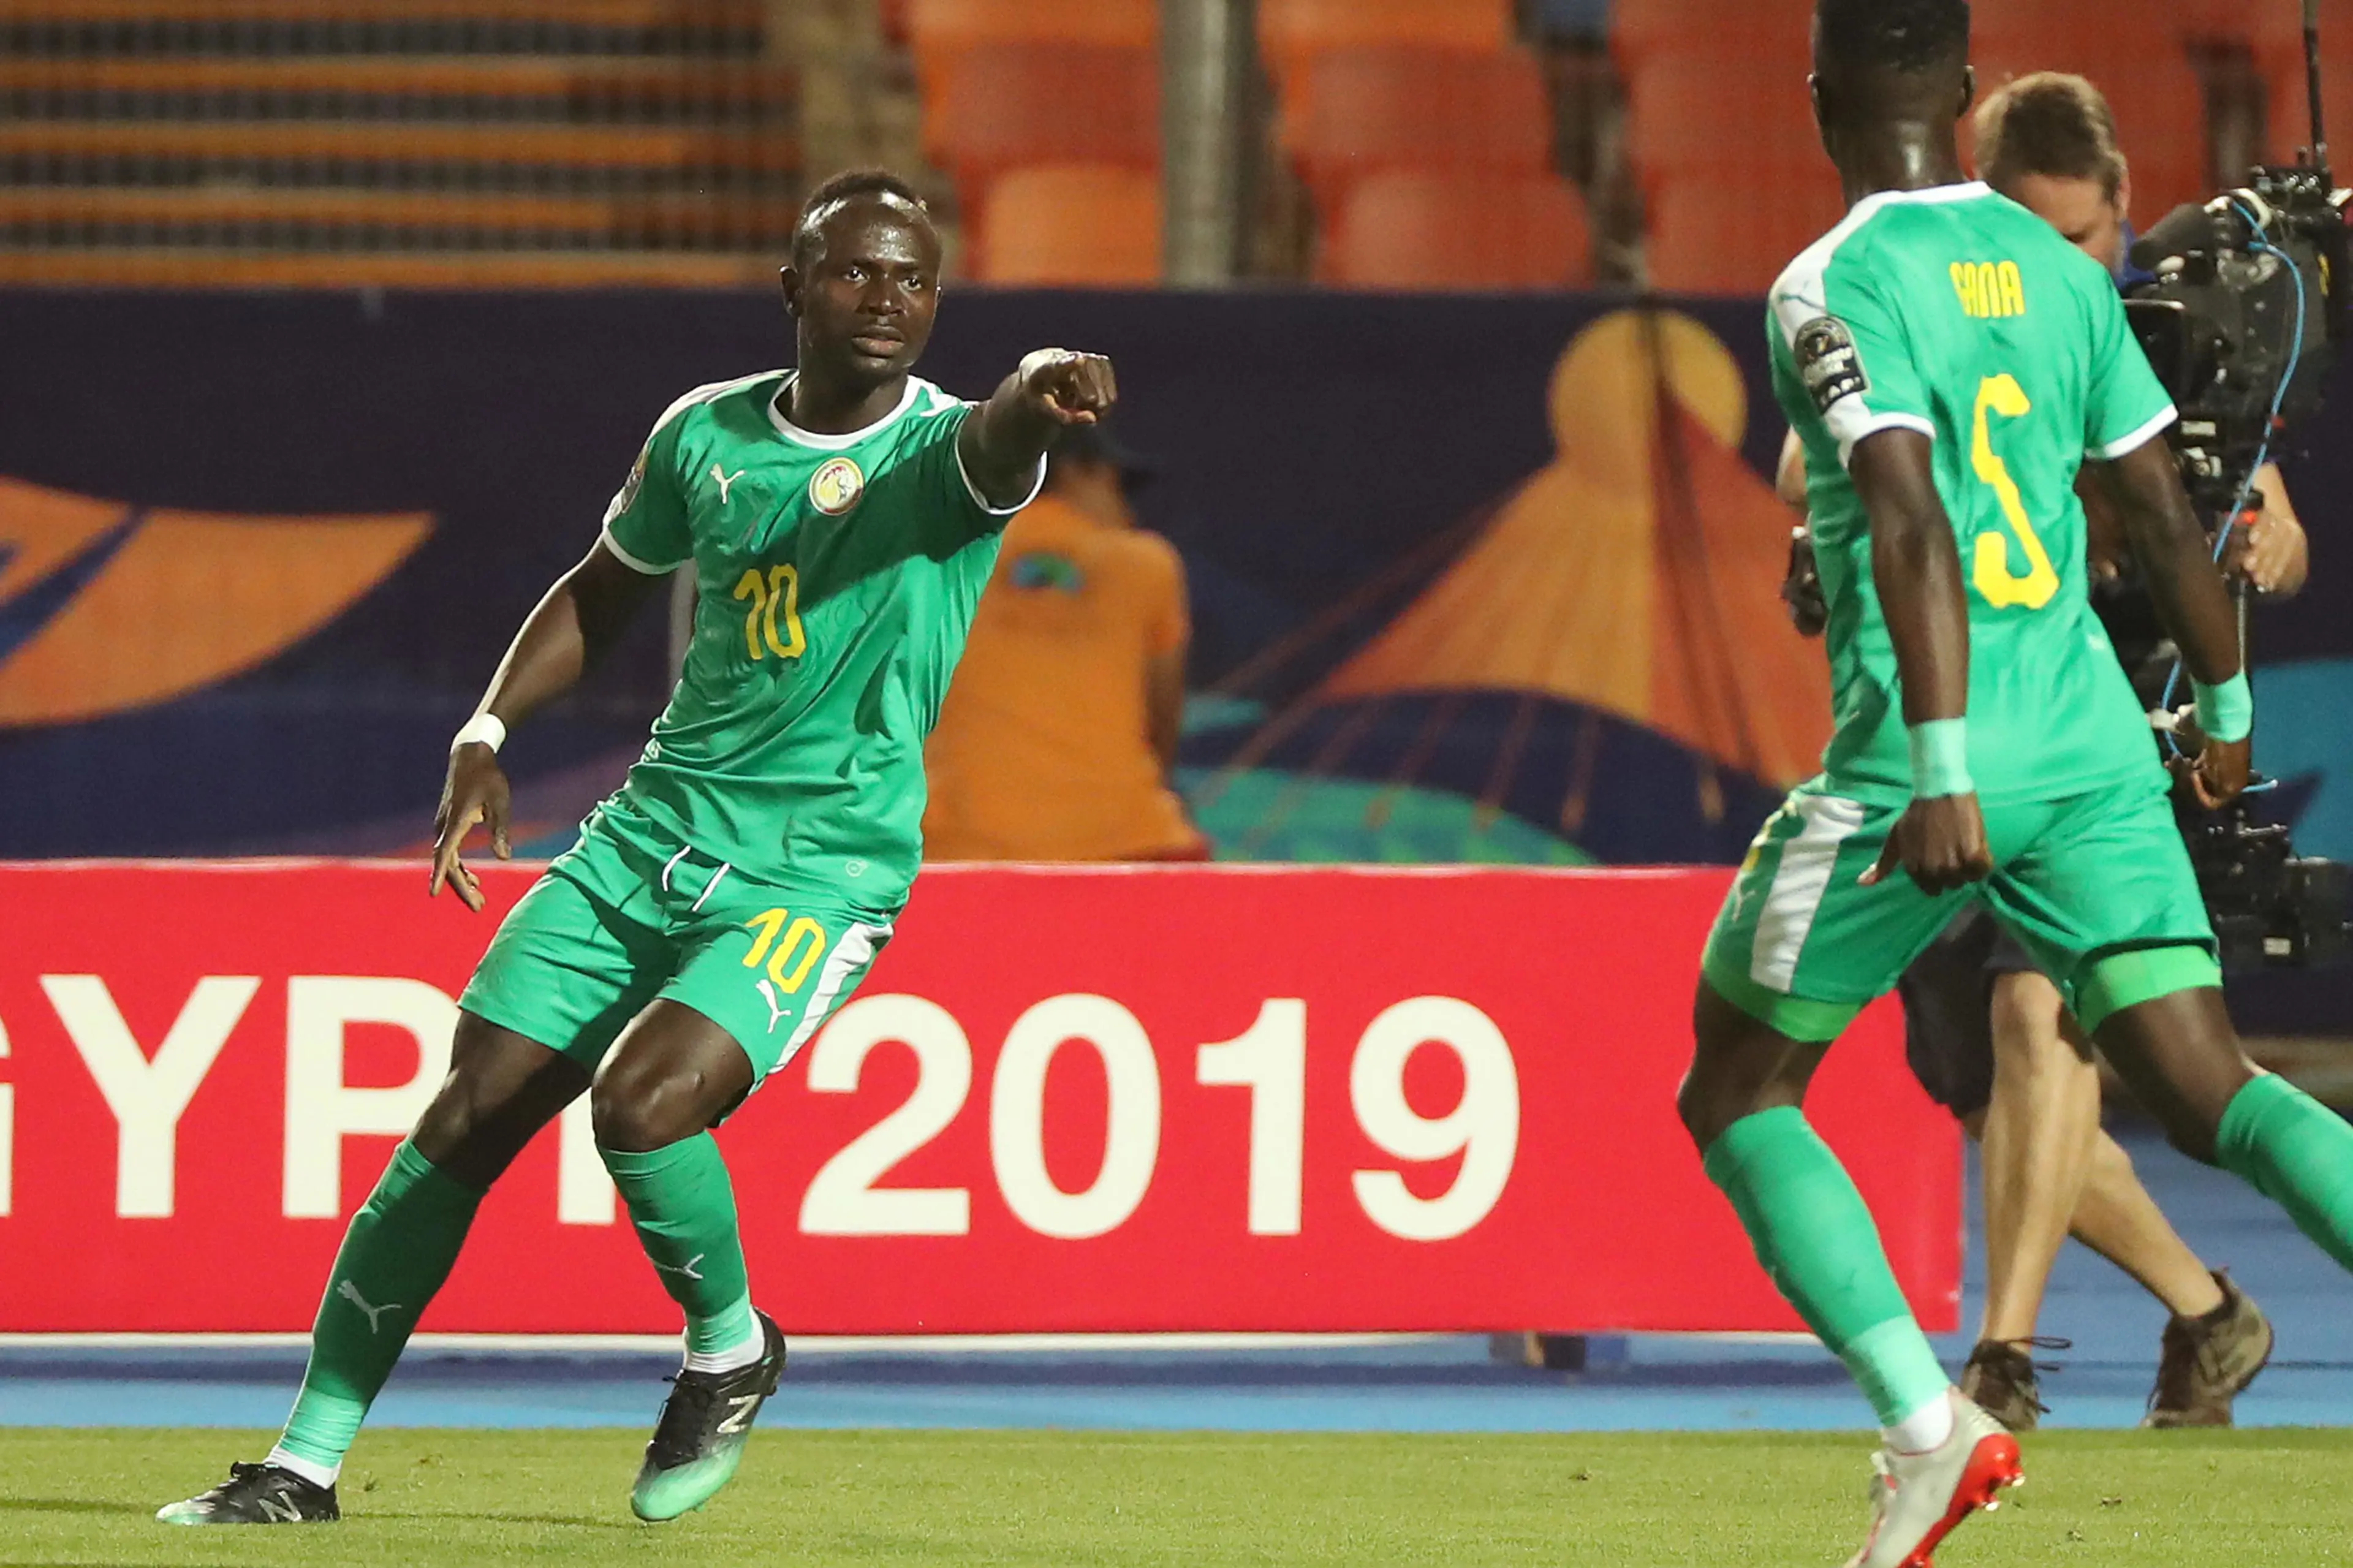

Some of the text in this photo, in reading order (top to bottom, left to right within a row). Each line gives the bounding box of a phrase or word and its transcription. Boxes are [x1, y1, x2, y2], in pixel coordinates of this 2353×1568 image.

[1971, 373, 2060, 609] 5
[733, 563, 806, 660] 10
[742, 908, 826, 993] 10
[797, 993, 1521, 1241] 2019
